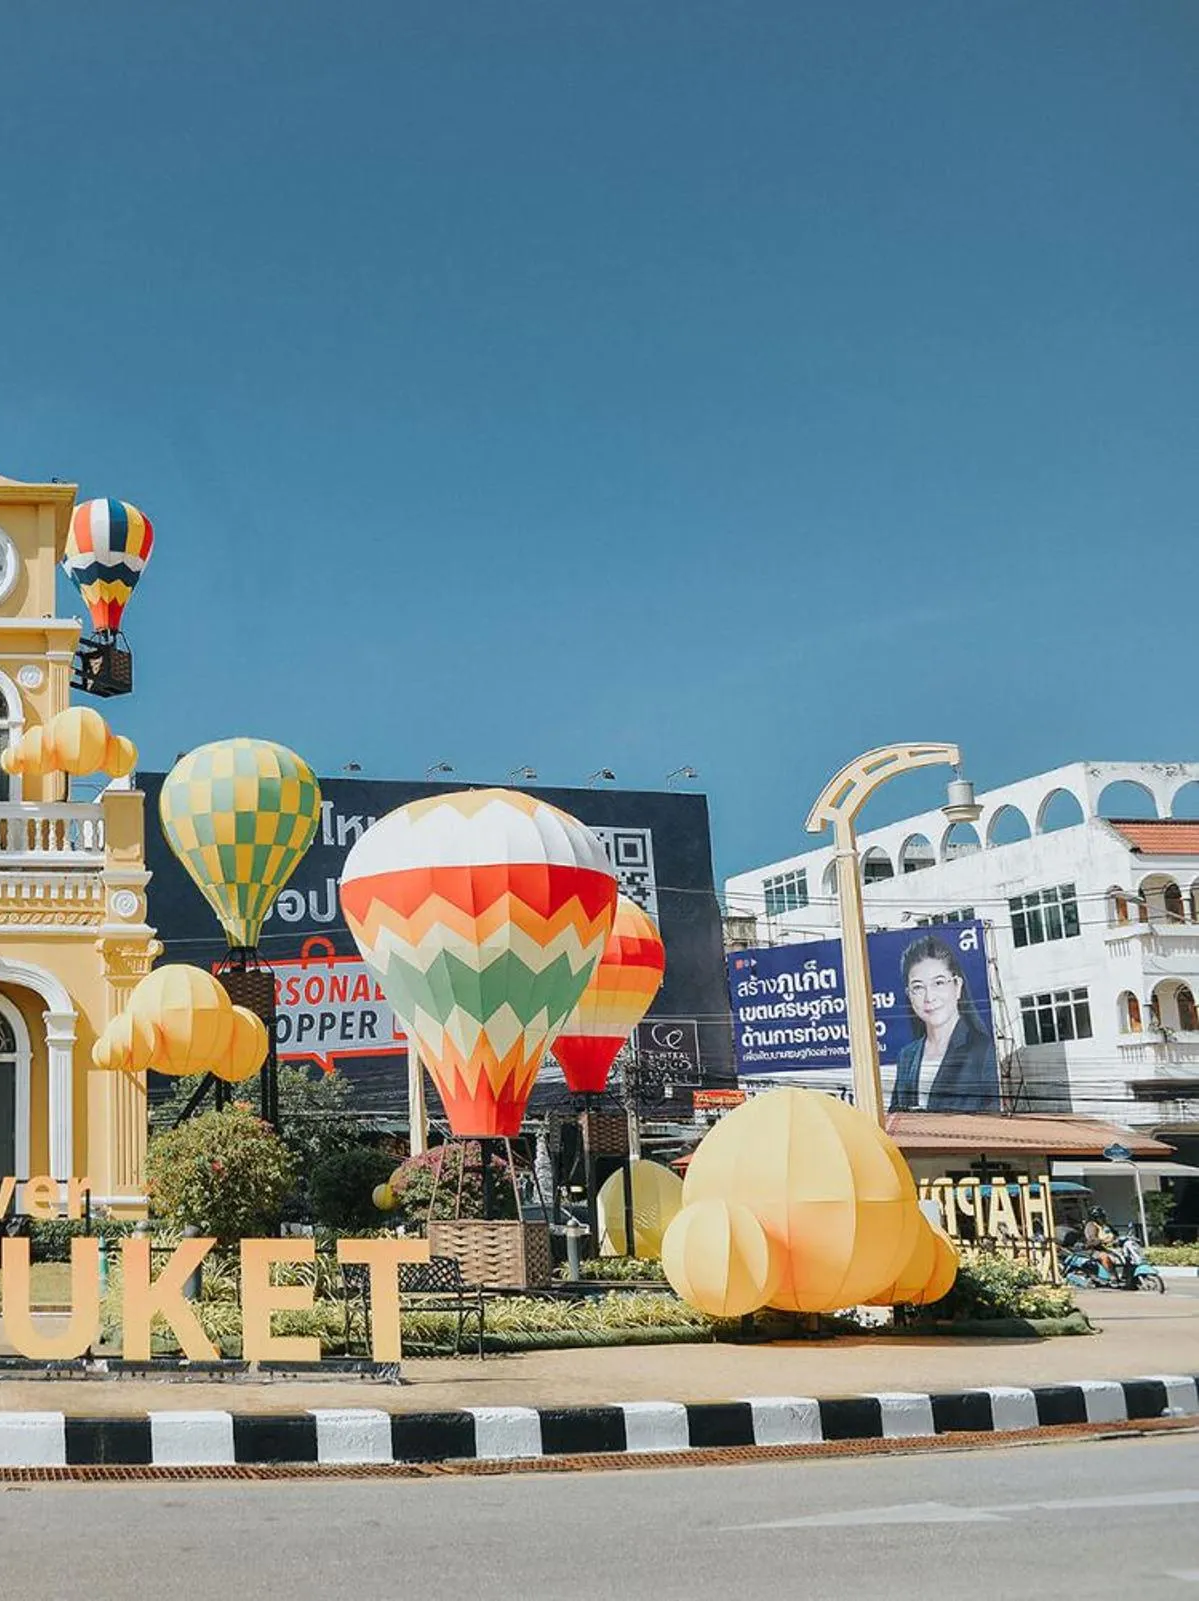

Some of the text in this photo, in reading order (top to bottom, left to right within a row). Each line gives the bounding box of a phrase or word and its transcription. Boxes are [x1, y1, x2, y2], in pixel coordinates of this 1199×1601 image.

[274, 973, 388, 1007] RSONAL
[737, 960, 837, 1001] สร้างภูเก็ต
[276, 1010, 378, 1044] OPPER
